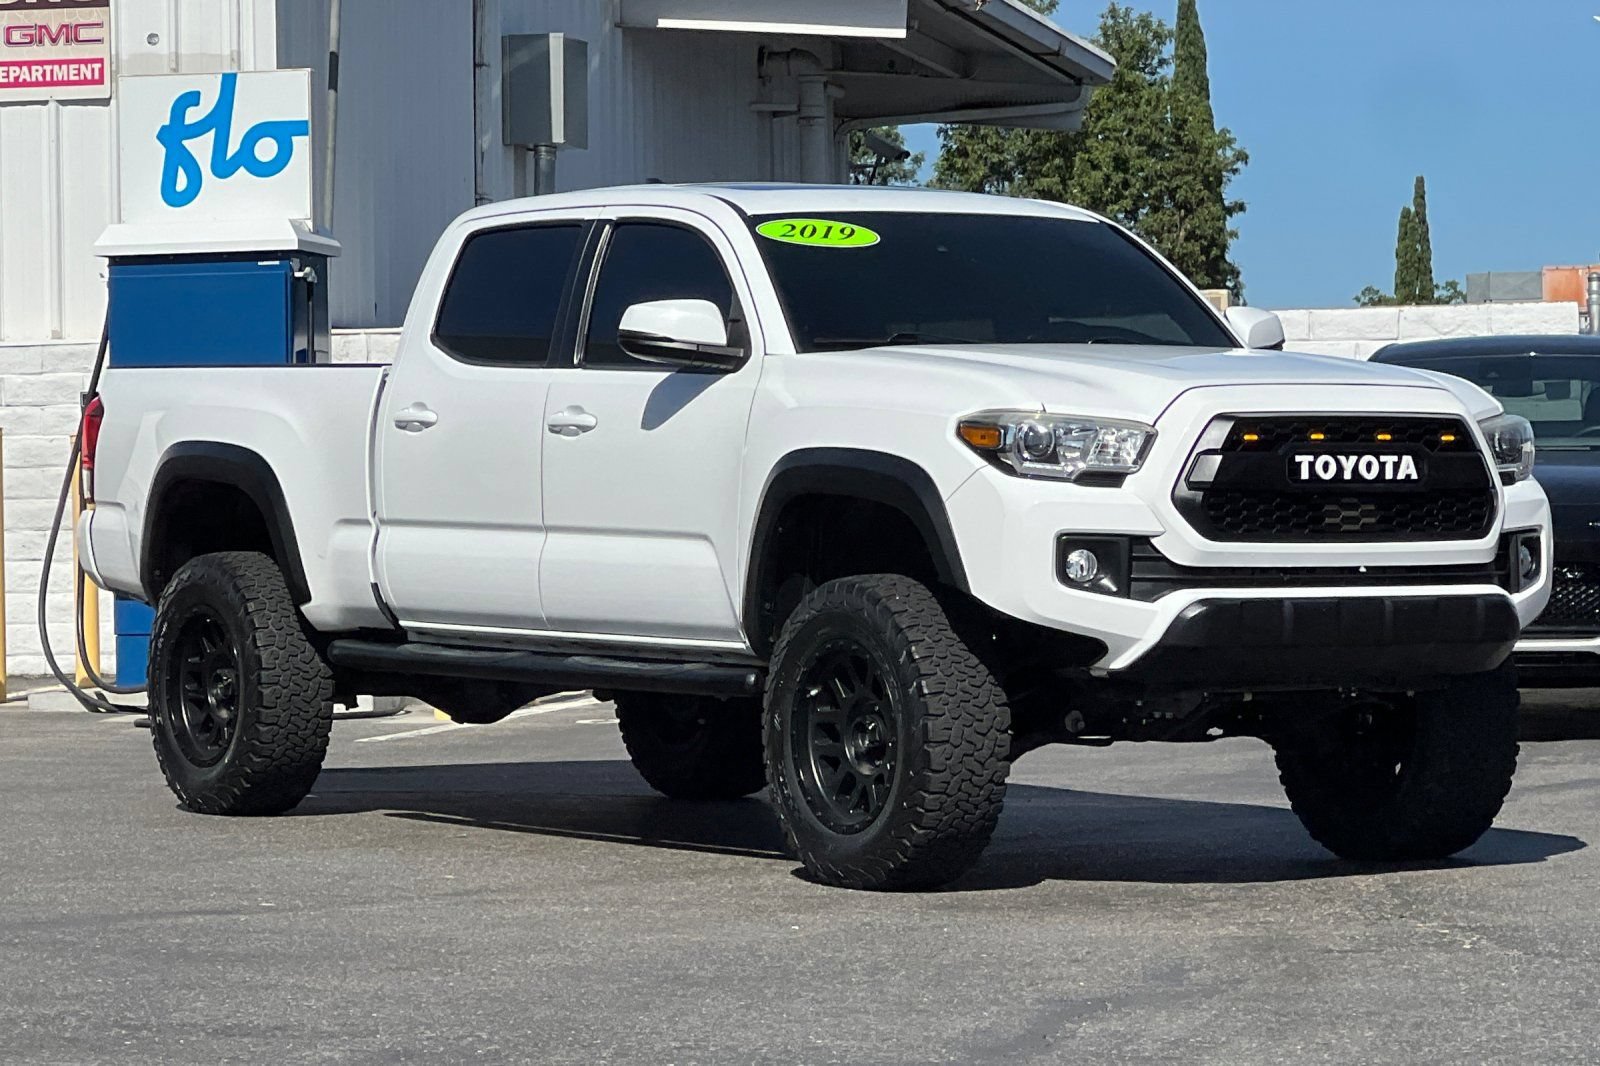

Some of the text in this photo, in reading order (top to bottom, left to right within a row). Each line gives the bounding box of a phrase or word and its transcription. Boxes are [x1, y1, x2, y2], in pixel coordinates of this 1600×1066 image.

[4, 21, 104, 47] GMC
[0, 63, 101, 83] EPARTMENT
[156, 72, 309, 208] flo
[780, 223, 856, 240] 2019
[1295, 454, 1418, 480] TOYOTA
